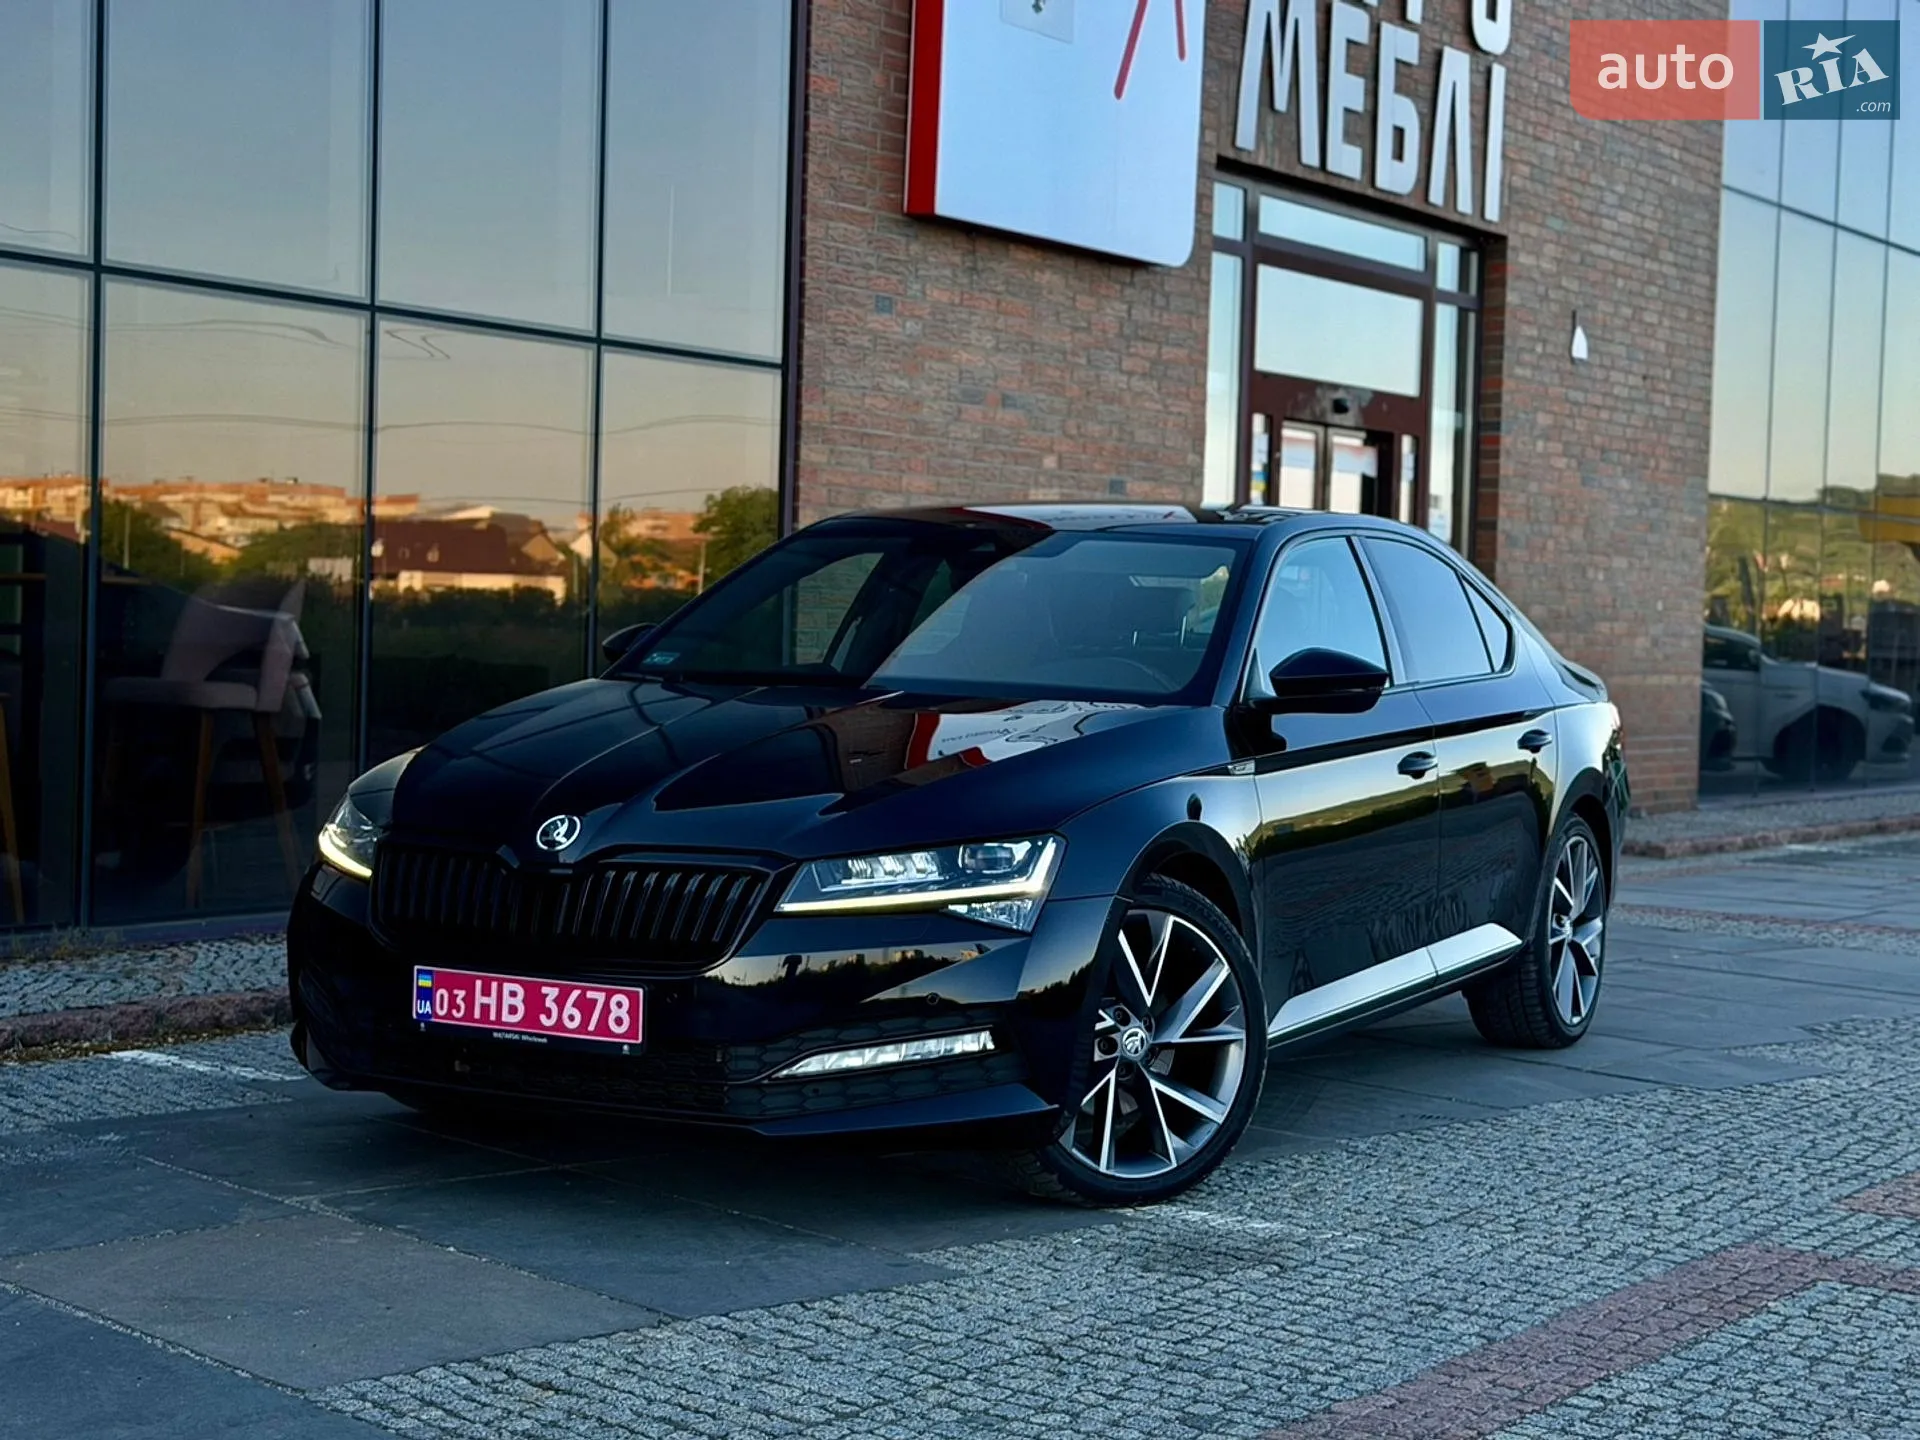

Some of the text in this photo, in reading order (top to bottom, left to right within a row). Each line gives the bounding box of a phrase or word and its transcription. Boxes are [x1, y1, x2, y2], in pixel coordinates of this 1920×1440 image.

[1235, 0, 1507, 222] МЕБЛІ
[417, 999, 432, 1014] UA
[435, 979, 631, 1034] 03 HB 3678
